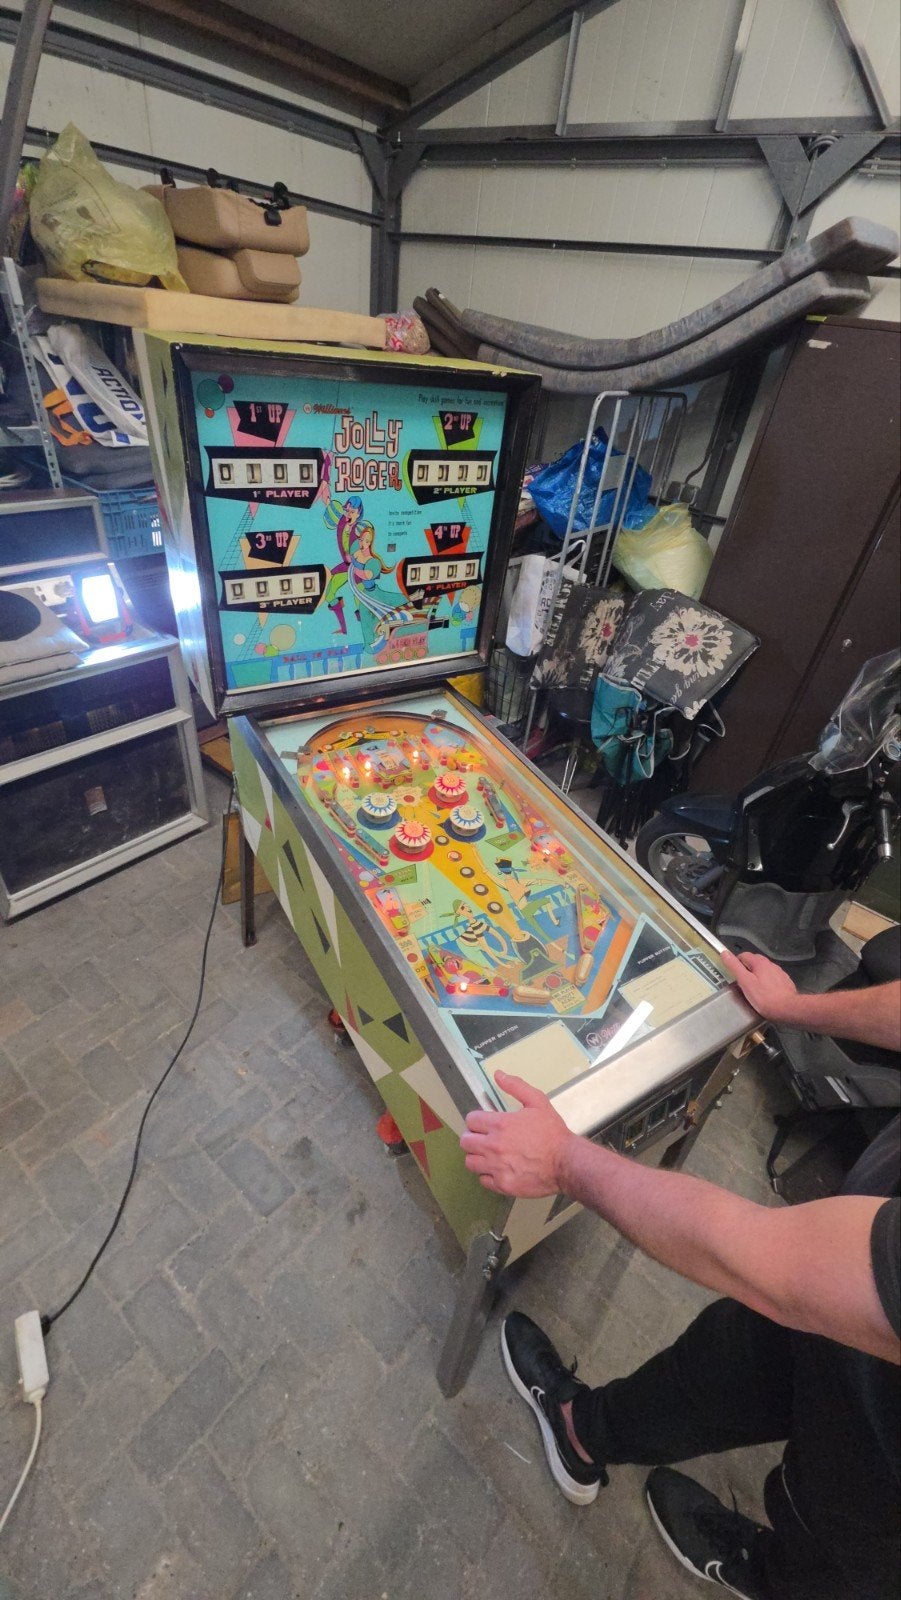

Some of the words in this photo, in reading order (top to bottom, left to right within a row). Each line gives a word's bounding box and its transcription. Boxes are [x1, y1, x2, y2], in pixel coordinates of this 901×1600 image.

[267, 403, 283, 423] UP
[460, 414, 472, 430] UP
[335, 411, 403, 459] JOLLY
[335, 456, 402, 492] ROGER
[265, 490, 310, 498] PLAYER
[275, 531, 289, 548] UP
[450, 524, 461, 539] UP
[436, 582, 467, 590] PLAYER
[273, 597, 313, 607] PLAYER
[654, 946, 671, 956] BUTTON
[474, 1036, 496, 1051] FLIPPER
[497, 1024, 519, 1040] BUTTON
